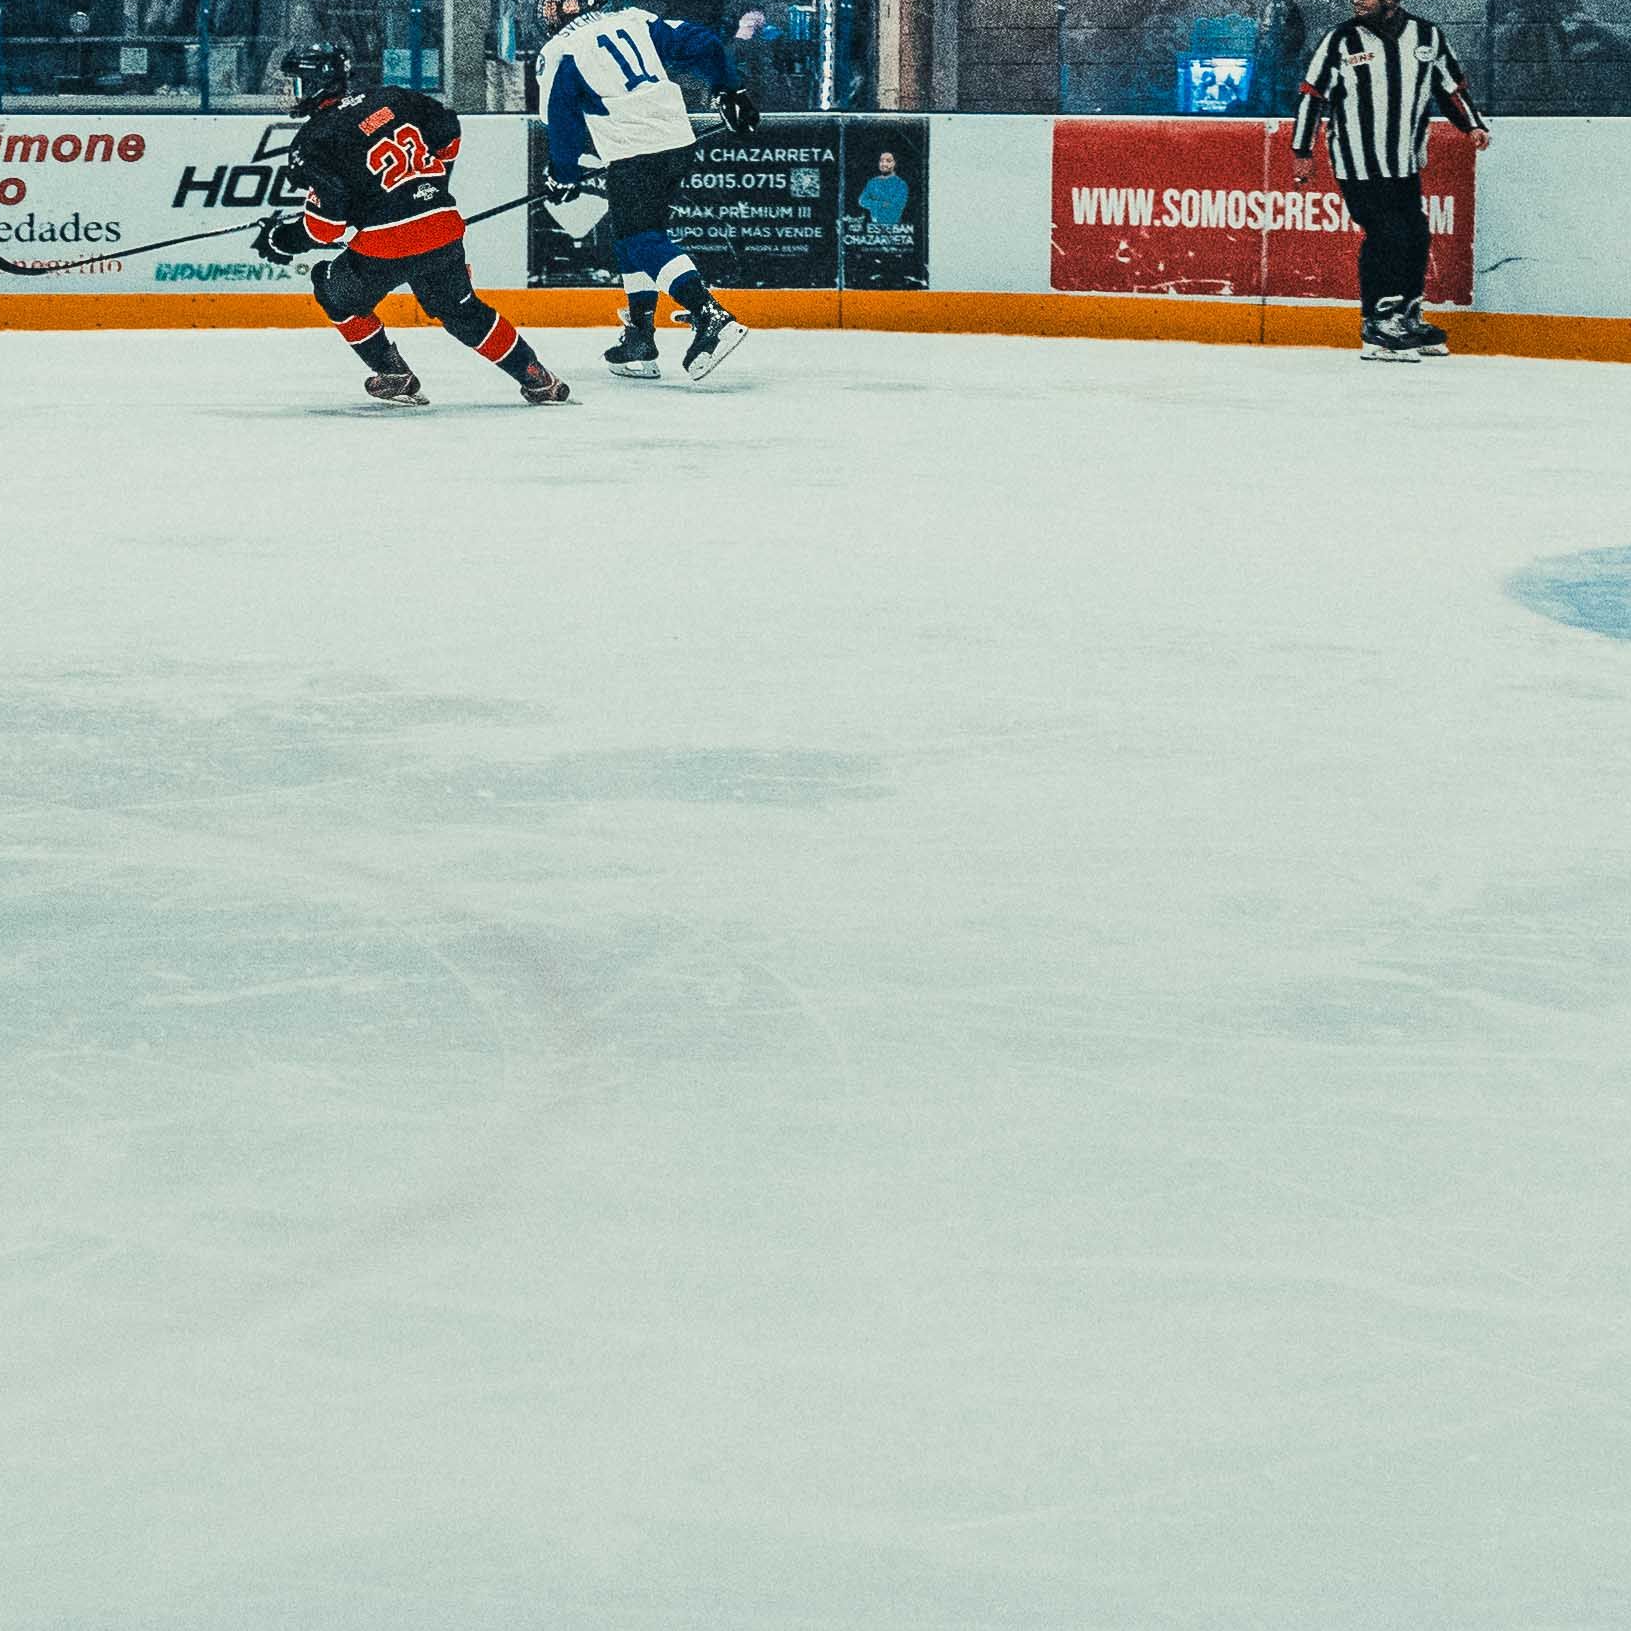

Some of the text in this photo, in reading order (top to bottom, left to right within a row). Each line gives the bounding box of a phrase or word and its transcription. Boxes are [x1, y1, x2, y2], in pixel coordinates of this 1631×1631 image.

[596, 28, 660, 92] 11
[367, 123, 445, 193] 22
[709, 148, 835, 163] CHAZARRETA
[775, 226, 823, 238] VENDE
